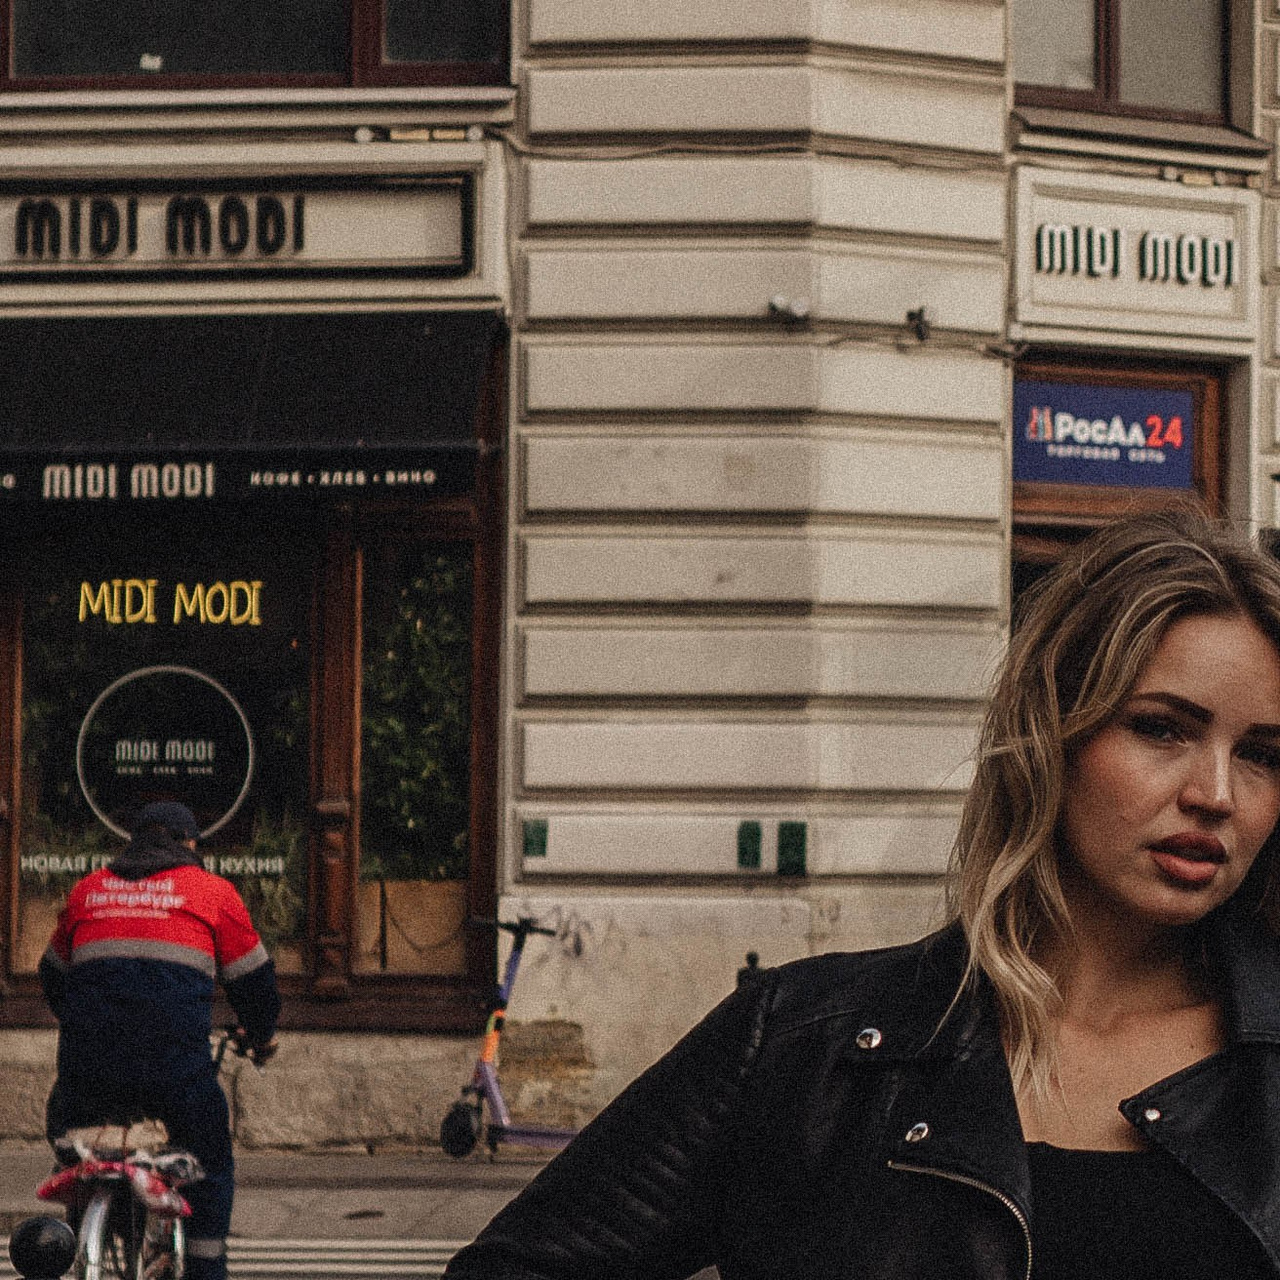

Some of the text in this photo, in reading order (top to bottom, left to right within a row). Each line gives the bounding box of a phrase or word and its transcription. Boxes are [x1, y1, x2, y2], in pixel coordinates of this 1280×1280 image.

[15, 194, 305, 257] MIDI MODI
[1035, 222, 1239, 288] MIDI MODI
[43, 463, 118, 499] MIDI
[131, 462, 215, 499] MODI
[79, 579, 263, 626] MIDI MODI
[115, 739, 214, 762] MIDI MODI
